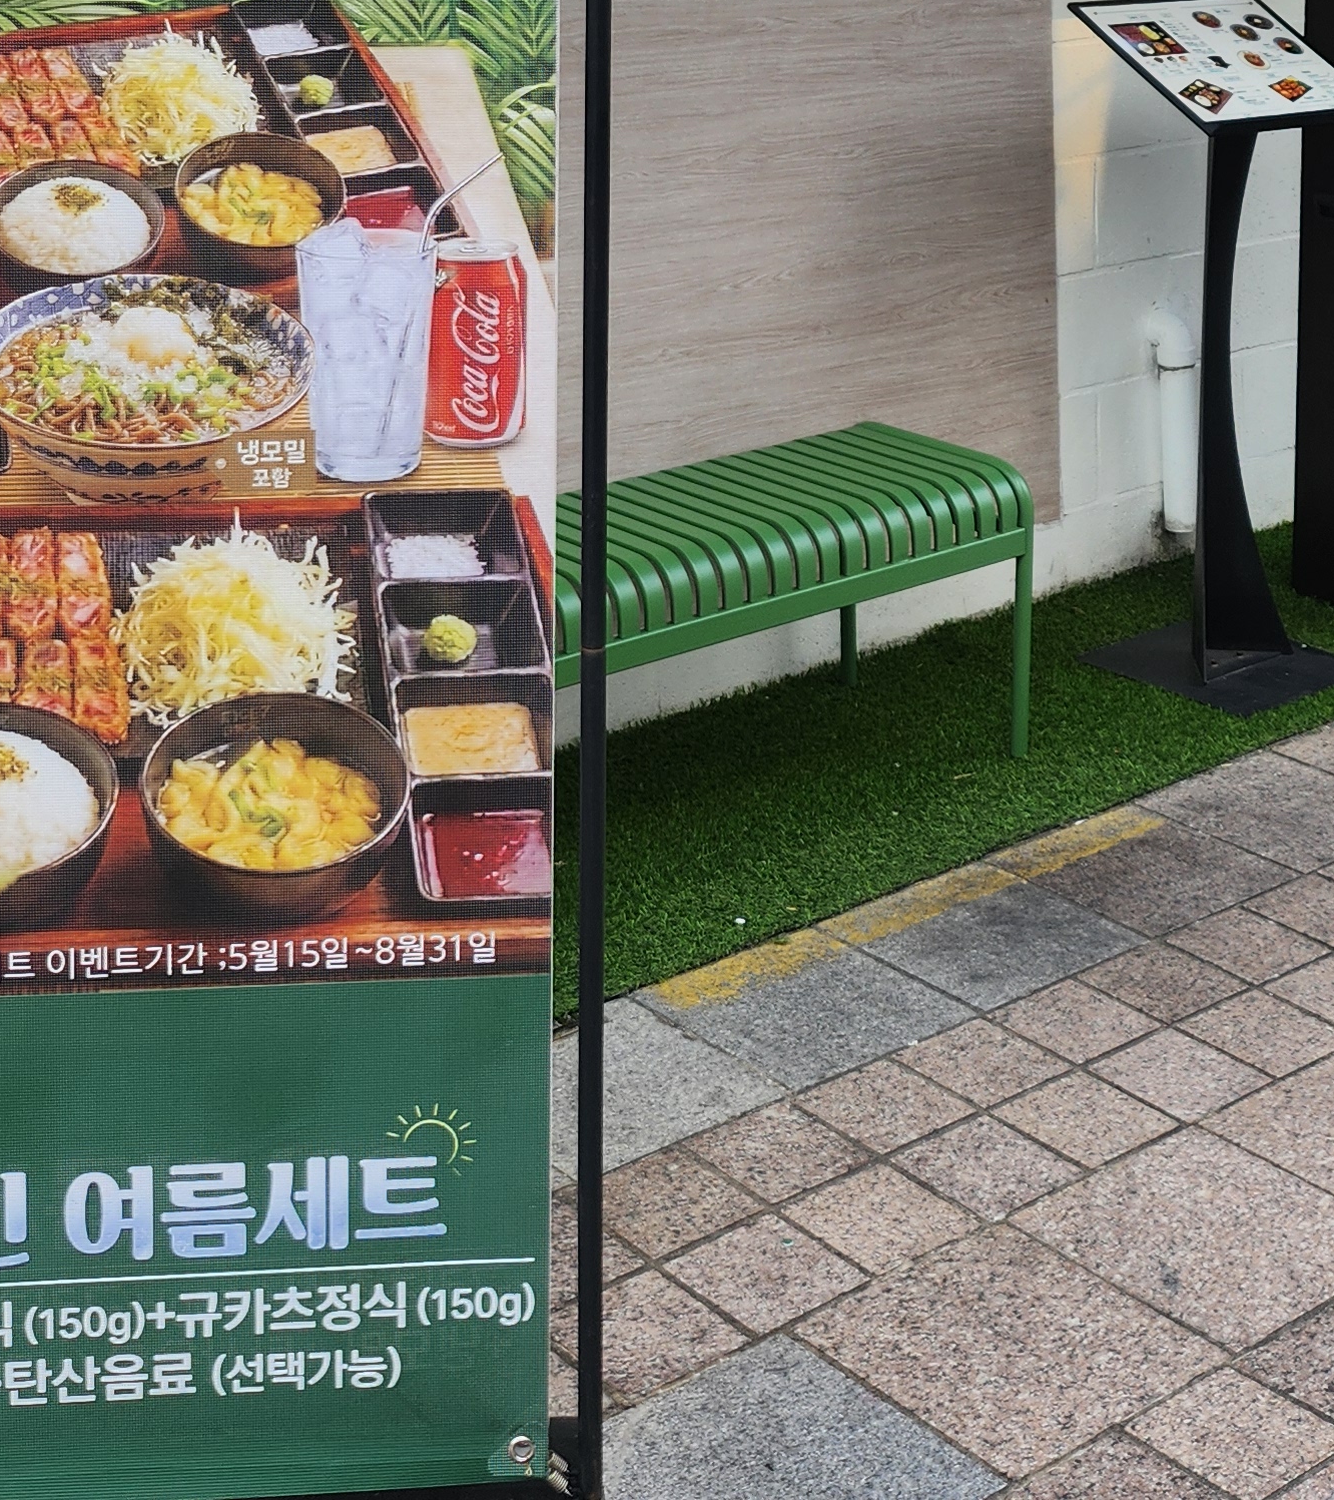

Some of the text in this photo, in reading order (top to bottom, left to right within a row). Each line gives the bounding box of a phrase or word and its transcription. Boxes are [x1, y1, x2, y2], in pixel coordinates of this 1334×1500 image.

[236, 438, 307, 465] 냉모밀
[251, 468, 293, 489] 포함
[45, 942, 209, 980] 이벤트기간
[65, 1154, 448, 1263] 여름세트
[417, 1282, 536, 1328] (150g)
[212, 1346, 402, 1399] (선택가능)
